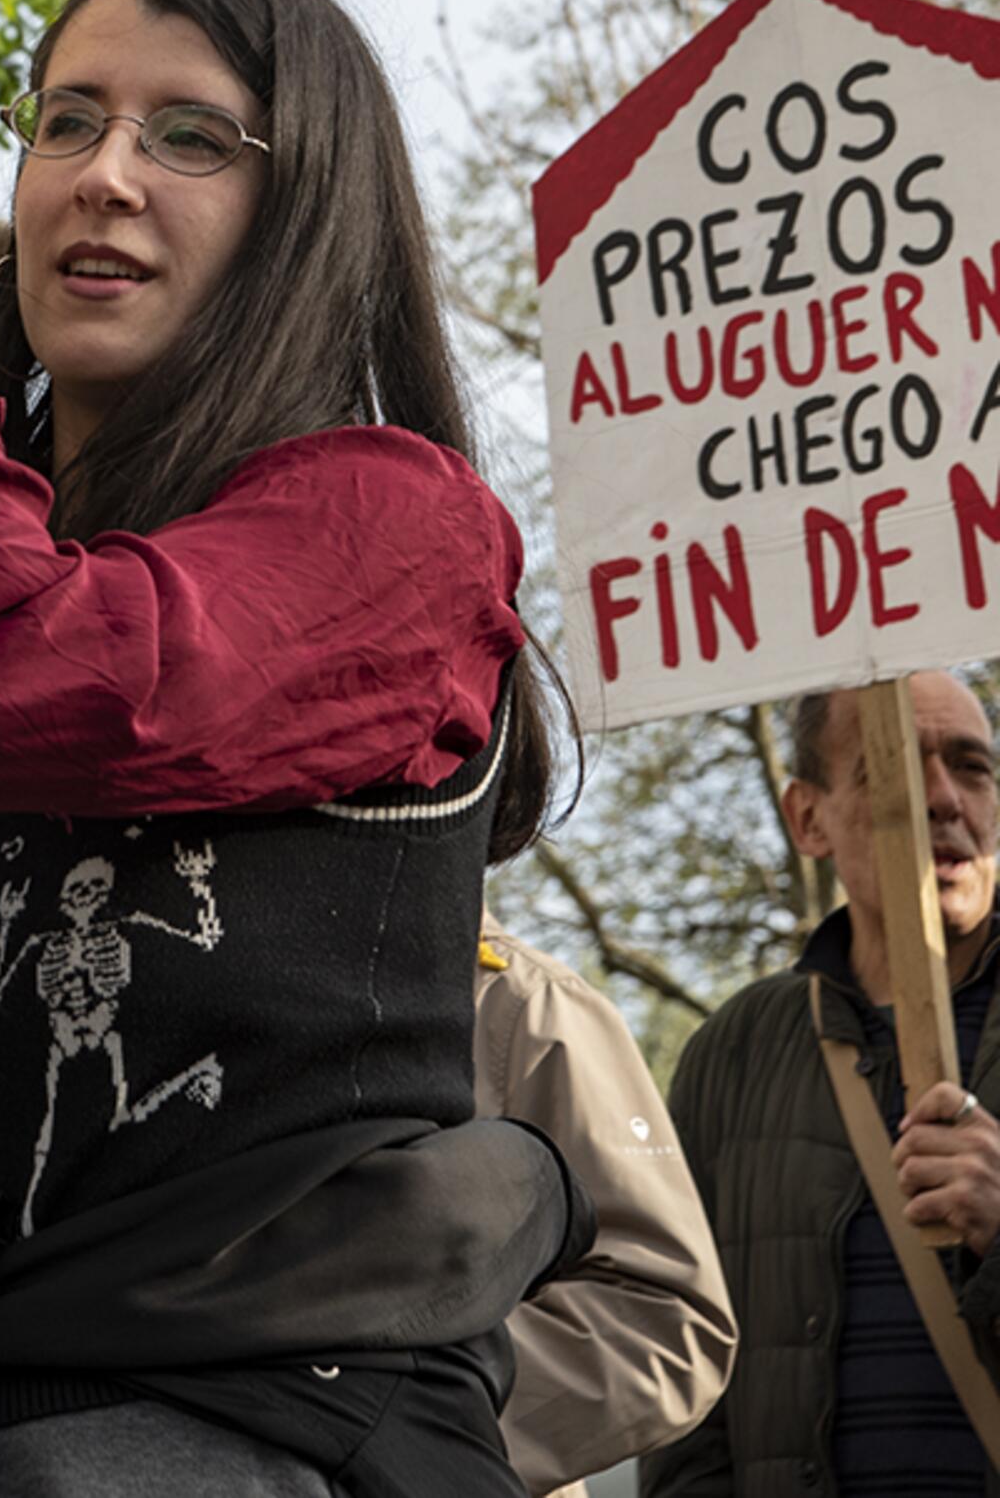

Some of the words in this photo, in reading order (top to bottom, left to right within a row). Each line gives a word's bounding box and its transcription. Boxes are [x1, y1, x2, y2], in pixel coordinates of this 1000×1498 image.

[697, 59, 898, 185] COS
[592, 153, 955, 327] PREZOS
[570, 270, 941, 424] ALUGUER
[697, 372, 943, 502] CHEGO
[802, 486, 922, 639] DE
